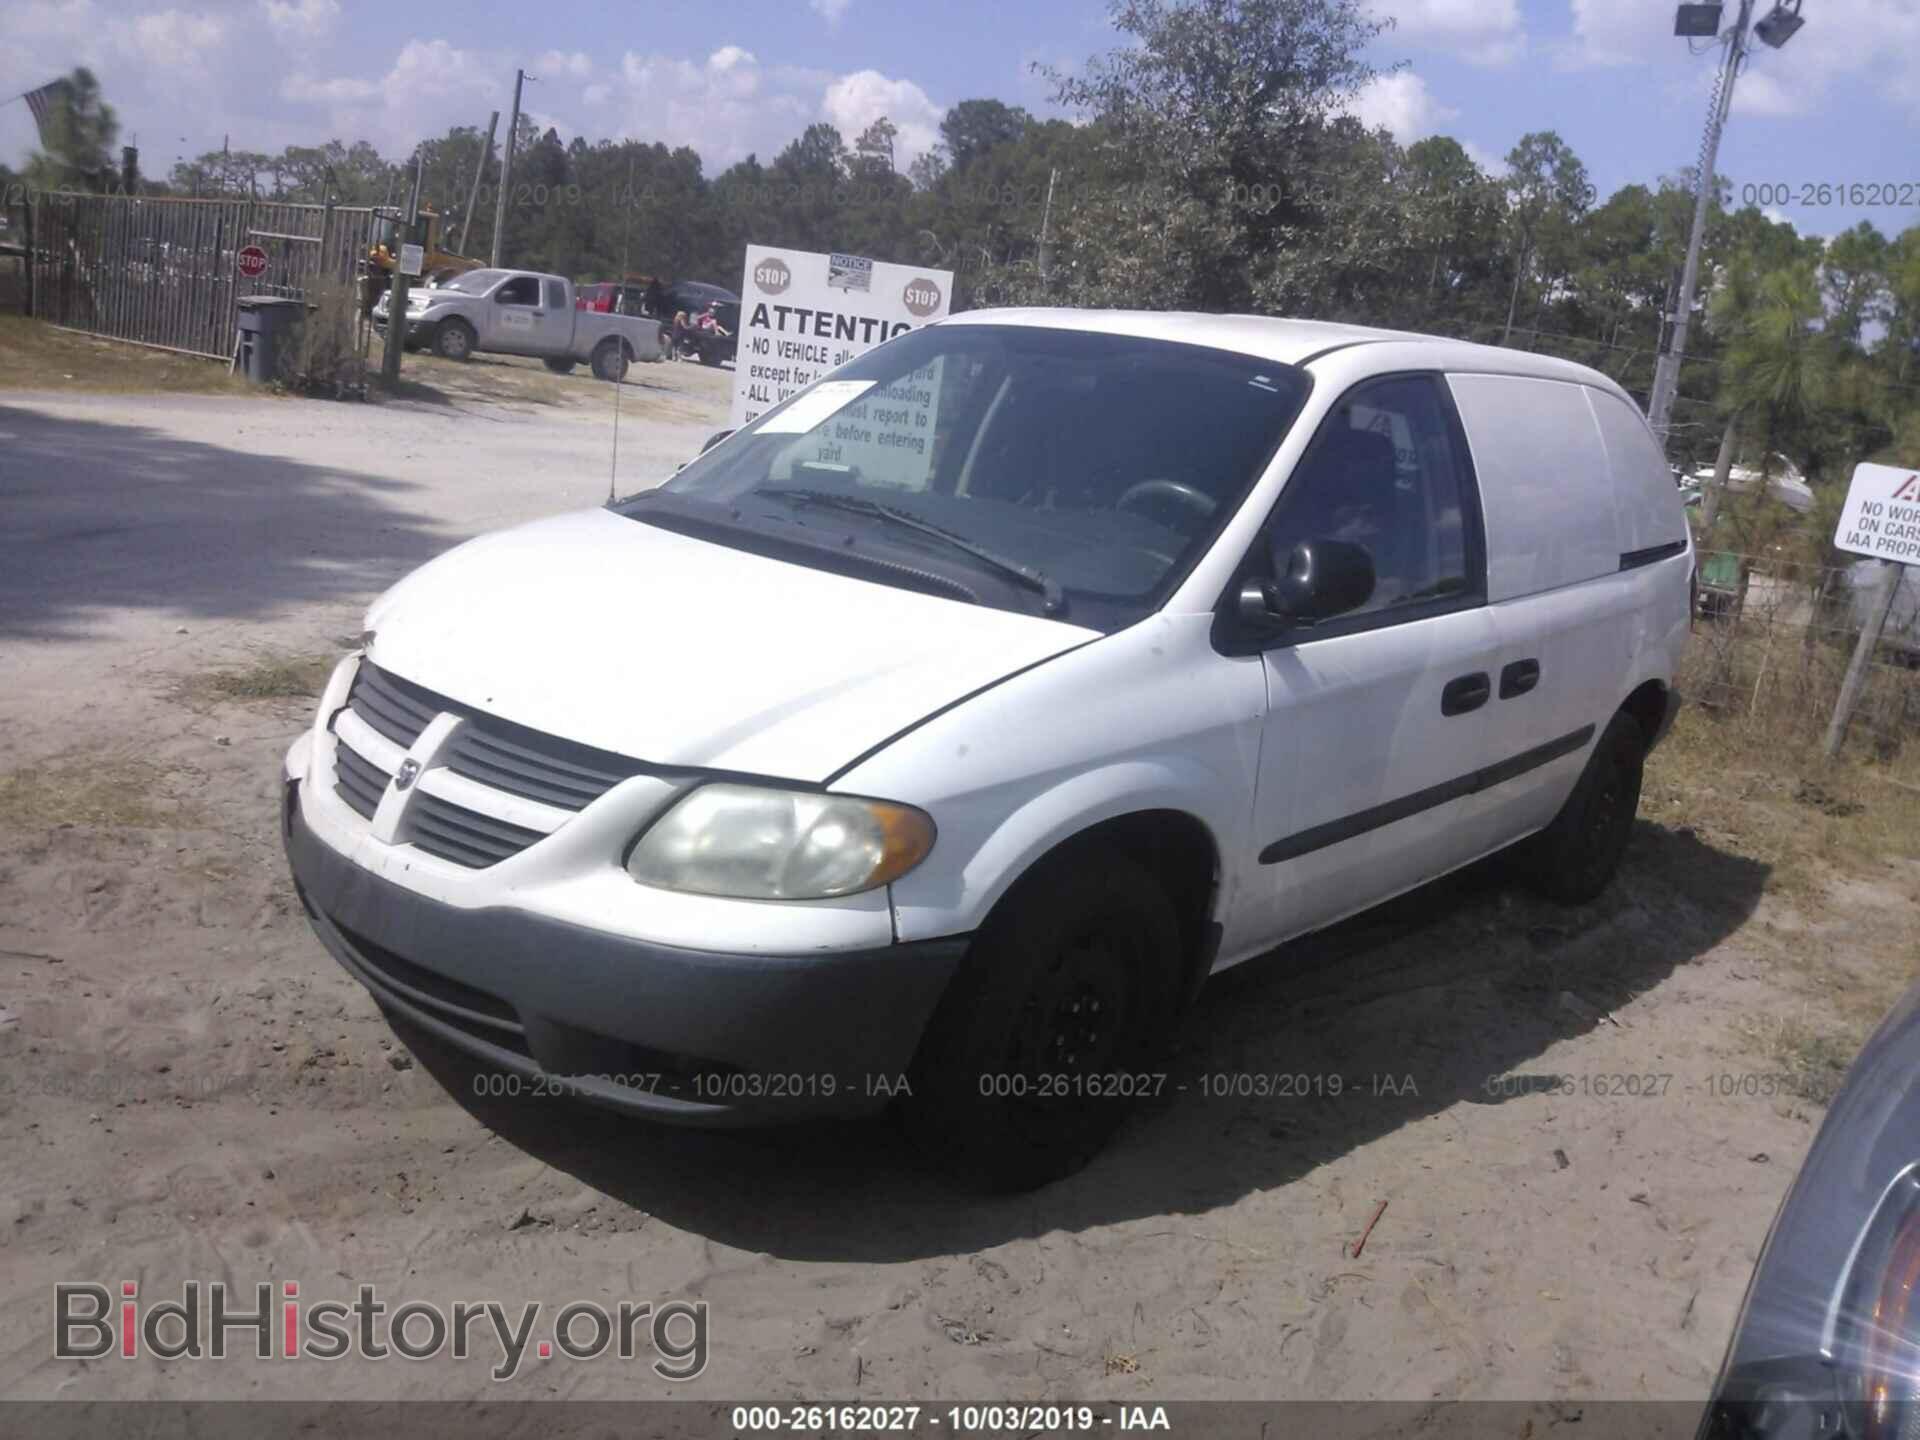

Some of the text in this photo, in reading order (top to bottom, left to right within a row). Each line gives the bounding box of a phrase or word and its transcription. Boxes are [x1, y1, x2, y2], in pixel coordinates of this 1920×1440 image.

[239, 255, 266, 269] STOP
[832, 255, 870, 271] NOTICE
[757, 268, 788, 286] STOP
[906, 288, 938, 307] STOP
[752, 336, 770, 355] NO
[777, 340, 828, 364] VEHICLE
[750, 365, 790, 385] except
[793, 366, 810, 385] for
[748, 384, 769, 403] ALL
[873, 408, 909, 426] report
[915, 412, 928, 427] to
[835, 423, 871, 442] before
[878, 432, 925, 455] entering
[818, 441, 842, 462] yard
[1861, 501, 1883, 517] NO
[1858, 517, 1880, 533] ON
[1846, 531, 1920, 558] IAA PROP
